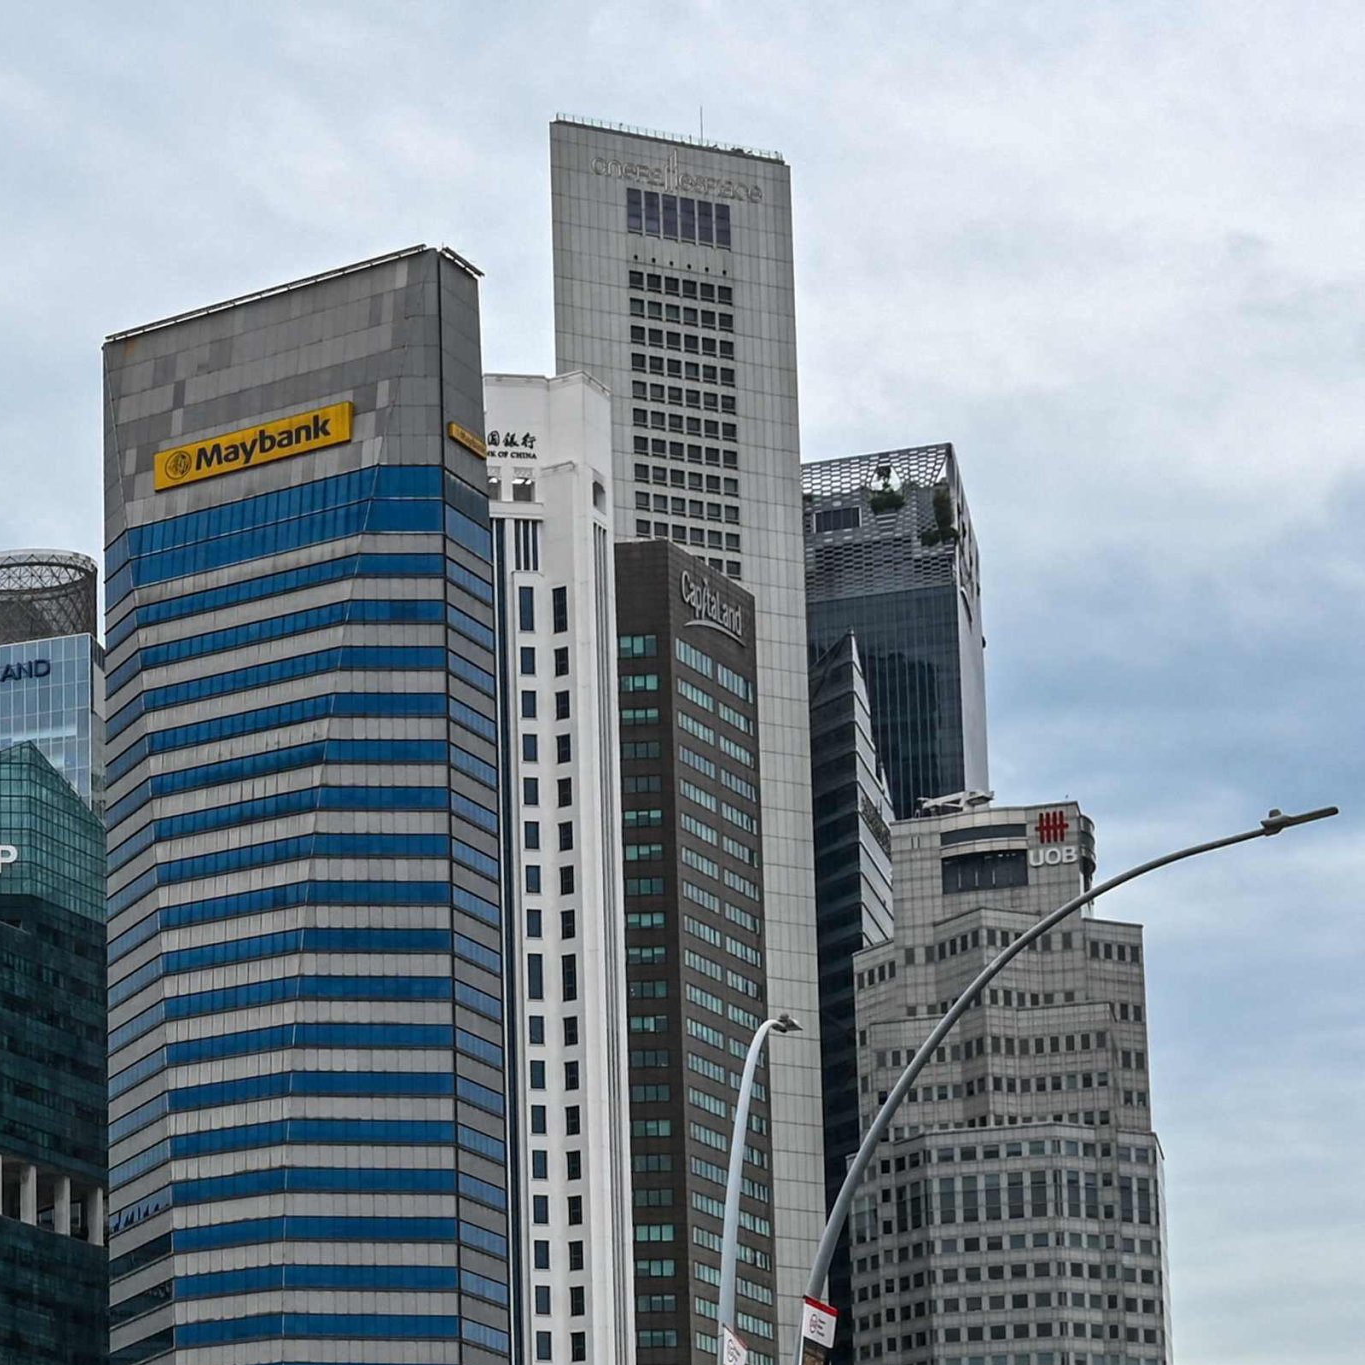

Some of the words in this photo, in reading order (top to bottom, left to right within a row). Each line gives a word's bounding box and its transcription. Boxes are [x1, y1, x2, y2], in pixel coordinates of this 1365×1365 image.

[196, 414, 331, 472] Maybank
[487, 430, 537, 449] 國銀行
[510, 451, 537, 459] CHINA
[681, 570, 742, 636] CapitaLand
[1028, 847, 1079, 867] UOB
